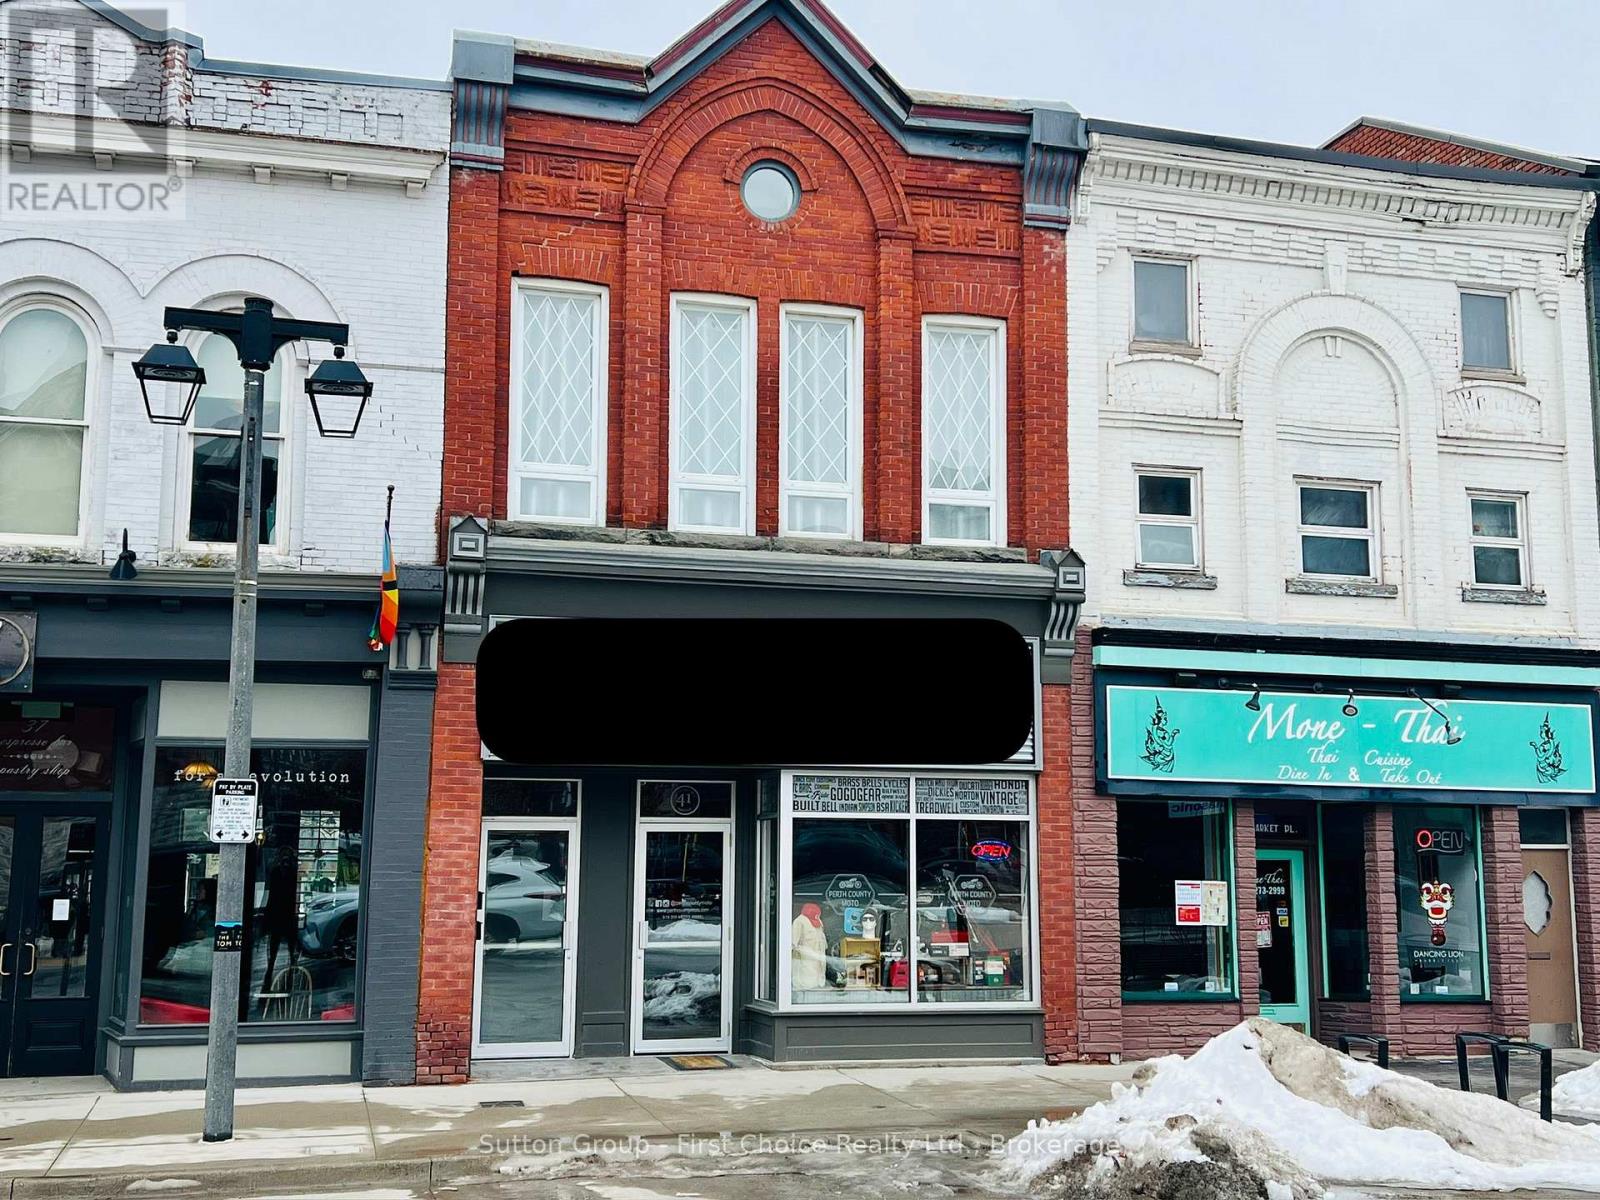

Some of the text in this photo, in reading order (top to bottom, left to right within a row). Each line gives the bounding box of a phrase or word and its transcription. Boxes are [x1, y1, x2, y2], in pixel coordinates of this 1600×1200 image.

[1248, 702, 1346, 743] Mone
[1394, 700, 1466, 744] Thai
[1306, 740, 1413, 766] Thai Cuisine
[42, 762, 71, 779] shop
[174, 769, 205, 781] for
[249, 770, 350, 783] evolution
[1277, 765, 1442, 785] Dine In & Take Out
[838, 778, 860, 787] BRASS
[883, 779, 908, 788] CYCLES
[993, 780, 1028, 790] HONDA
[830, 787, 881, 801] GOGOGEAR
[928, 786, 954, 797] DICKIES
[954, 790, 980, 800] NORTON
[980, 790, 1019, 805] VINTAGE
[675, 793, 691, 807] 41
[793, 800, 820, 811] BUILT
[960, 800, 979, 808] CUSTOM
[821, 801, 838, 812] BELL
[876, 802, 890, 812] BSA
[916, 801, 960, 814] TREADWELL
[1255, 823, 1279, 833] ARKET
[1417, 829, 1464, 849] OPEN
[971, 844, 1011, 858] OPEN
[848, 890, 871, 898] COUNTY
[1413, 950, 1464, 958] DANCING LION
